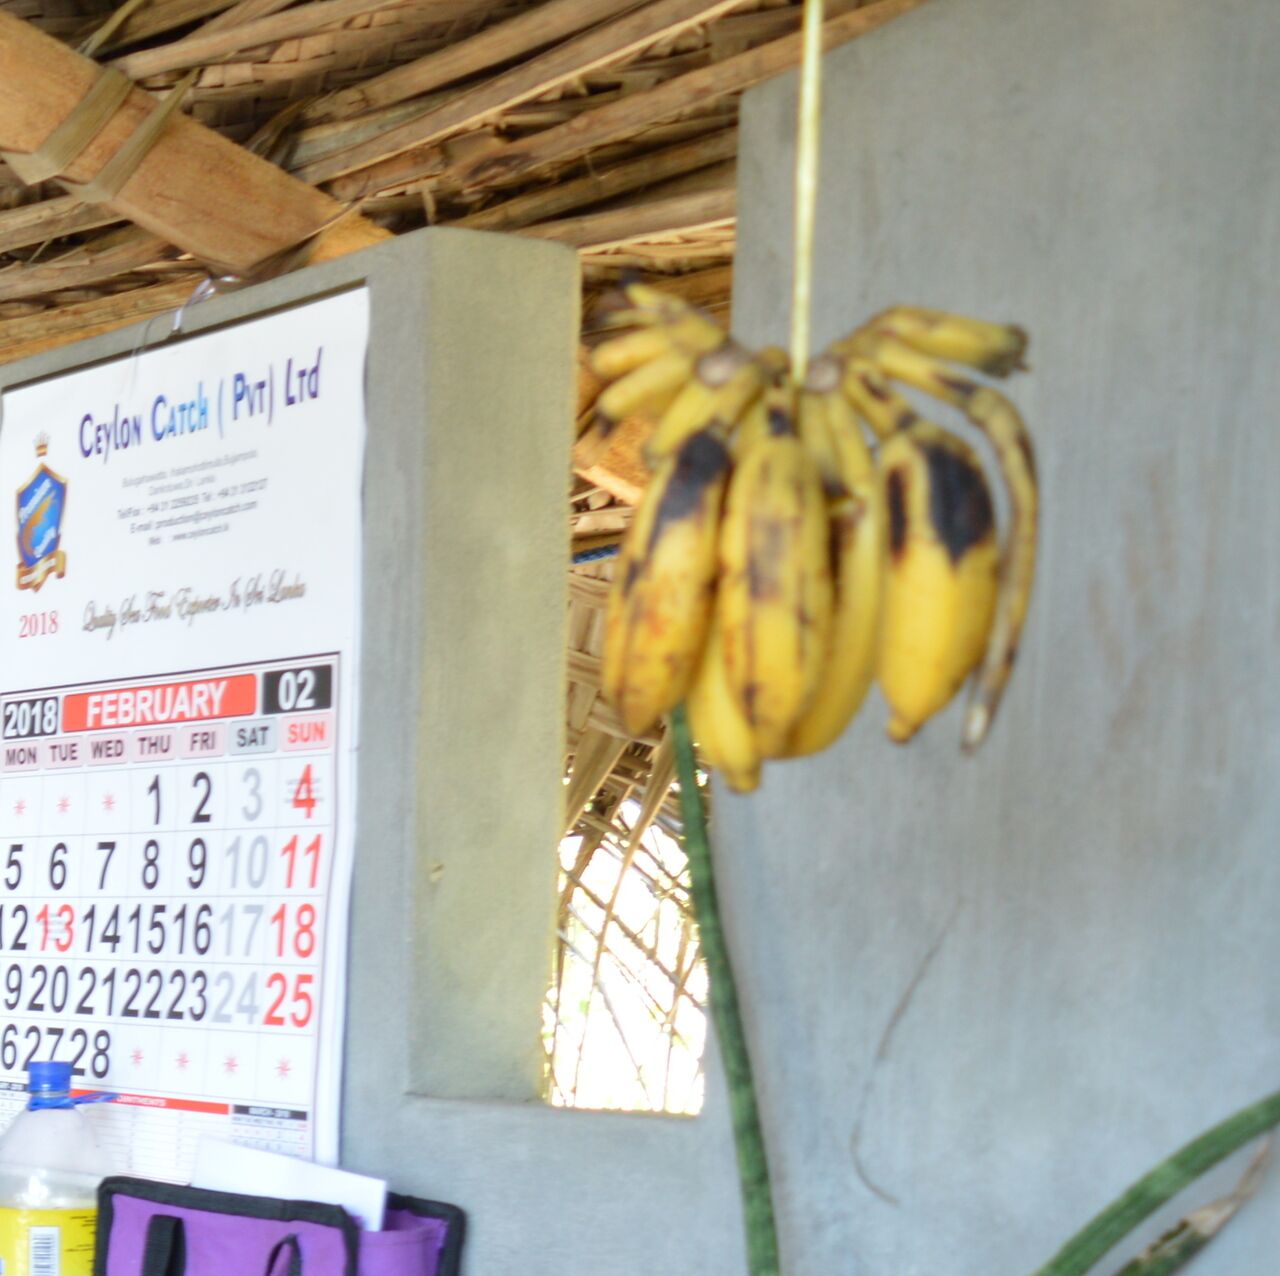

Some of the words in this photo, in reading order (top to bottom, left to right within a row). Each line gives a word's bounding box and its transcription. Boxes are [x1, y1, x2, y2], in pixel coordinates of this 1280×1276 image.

[18, 610, 59, 638] 2018
[3, 698, 58, 738] 2018
[87, 680, 228, 727] FEBRUARY
[278, 669, 316, 711] 02
[5, 744, 37, 767] MON
[49, 741, 78, 762] TUE
[91, 737, 124, 760] WED
[138, 733, 171, 755] THU
[190, 730, 216, 752] FRI
[236, 726, 269, 748] SAT
[288, 721, 325, 744] SUN
[147, 774, 160, 825] 1
[192, 771, 212, 823] 2
[242, 767, 262, 821] 3
[292, 763, 316, 819] 4
[4, 843, 24, 890] 5
[49, 842, 68, 890] 6
[97, 841, 116, 890] 7
[142, 838, 159, 890] 8
[188, 837, 207, 889] 9
[225, 835, 269, 889] 10
[281, 833, 322, 889] 11
[36, 904, 74, 951] 13
[82, 904, 120, 953] 14
[128, 904, 166, 954] 15
[174, 904, 212, 955] 16
[220, 904, 264, 957] 17
[271, 903, 316, 958] 18
[27, 964, 69, 1013] 20
[76, 966, 116, 1016] 21
[121, 968, 163, 1018] 22
[167, 969, 207, 1021] 23
[212, 970, 259, 1024] 24
[263, 972, 314, 1028] 25
[22, 1025, 64, 1071] 27
[70, 1028, 111, 1079] 28
